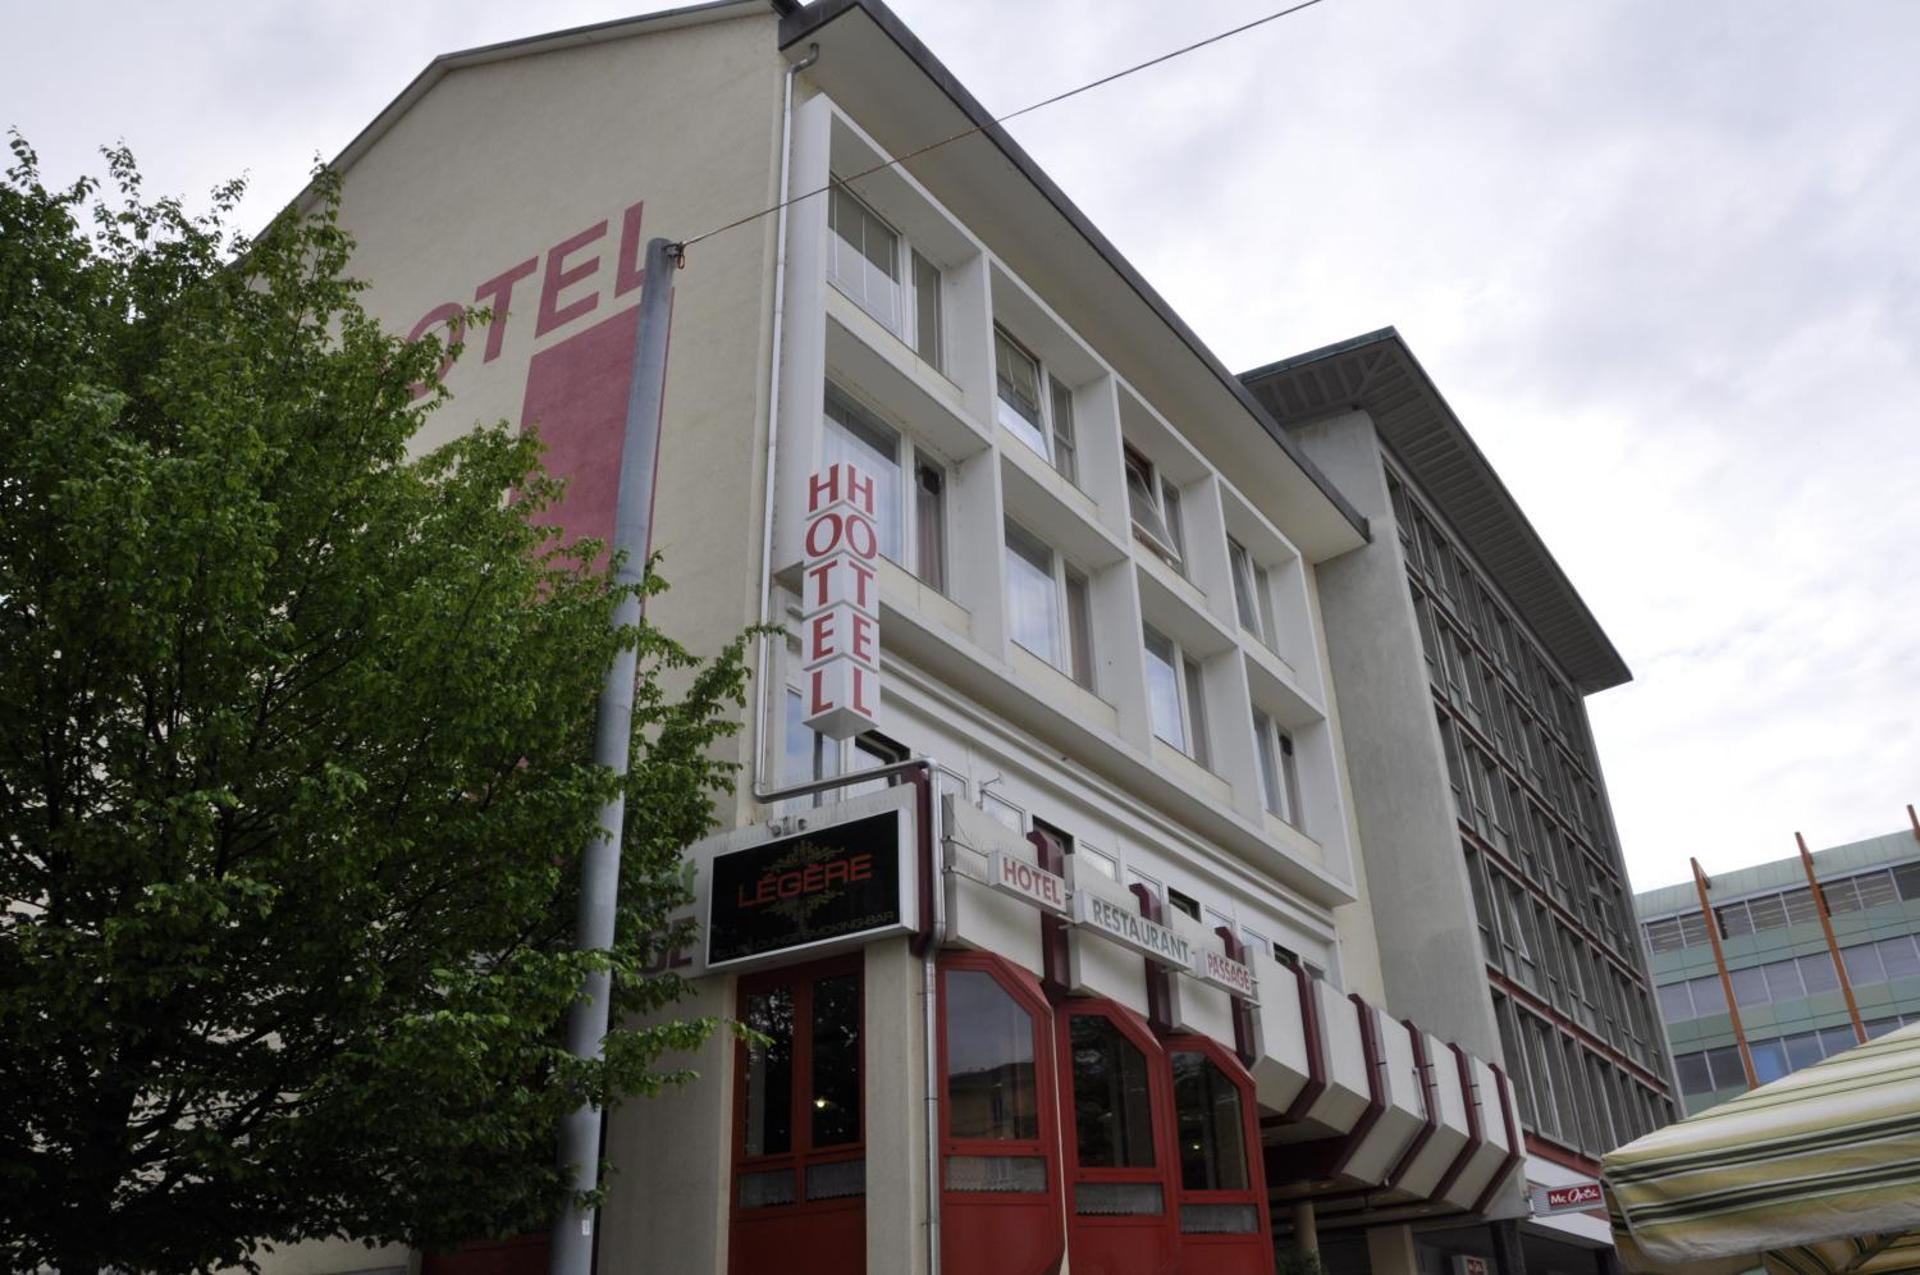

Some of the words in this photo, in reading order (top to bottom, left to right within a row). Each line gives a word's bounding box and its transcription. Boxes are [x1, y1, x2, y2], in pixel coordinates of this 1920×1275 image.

[402, 200, 647, 401] OTEL
[805, 463, 843, 716] HOTEL
[845, 464, 877, 718] HOTEL
[1003, 856, 1062, 905] HOTEL
[1092, 899, 1190, 963] RESTAURANT
[1207, 951, 1251, 991] PASSAGE
